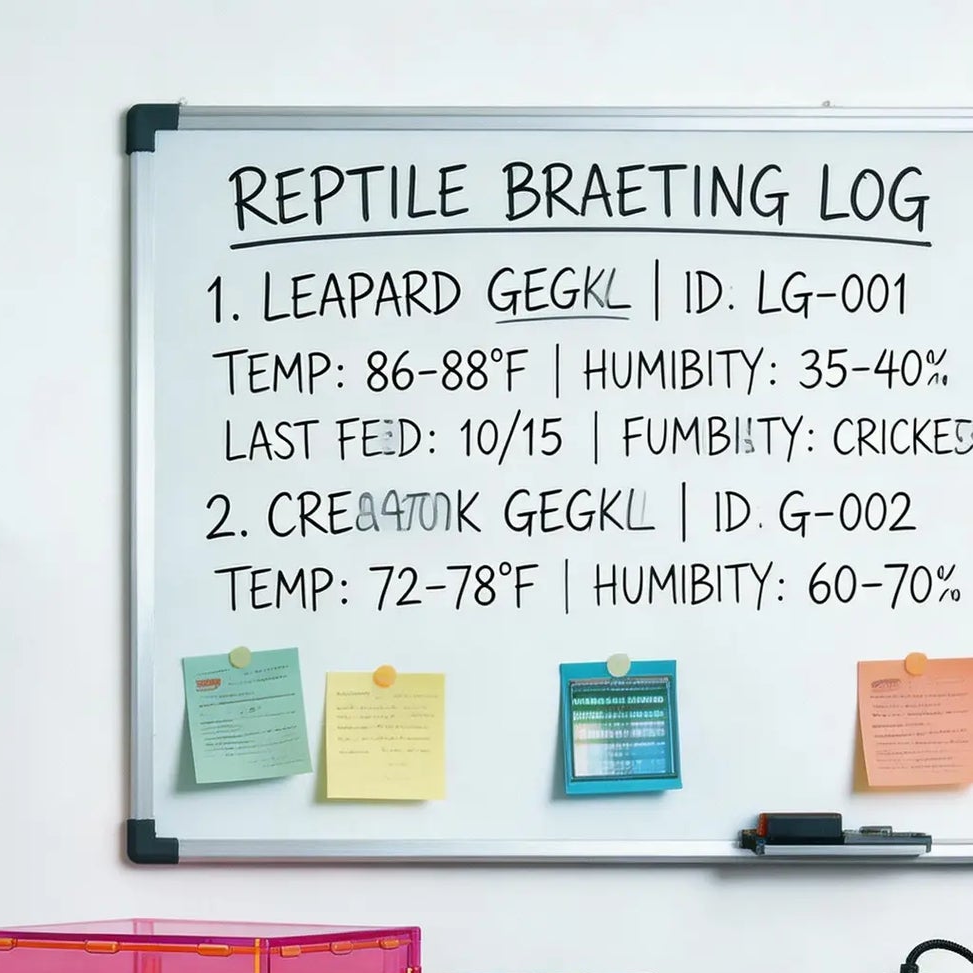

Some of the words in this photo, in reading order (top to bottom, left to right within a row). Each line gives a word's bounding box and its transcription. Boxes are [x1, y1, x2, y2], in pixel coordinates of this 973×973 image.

[228, 163, 470, 232] REPTILE
[501, 161, 791, 227] BRAETING
[819, 163, 931, 233] LOG
[207, 275, 240, 324] 1.
[263, 270, 462, 322] LEAPARD
[757, 269, 907, 320] LG-001
[211, 348, 344, 396] TEMP:
[366, 347, 529, 393] 86-88°F
[583, 346, 777, 396] HUMIBITY:
[225, 419, 320, 462] LAST
[460, 408, 563, 466] 10/15
[205, 493, 248, 540] 2.
[778, 489, 918, 539] G-002
[213, 565, 348, 613] TEMP:
[368, 561, 540, 612] 72-78°F
[593, 560, 785, 611] HUMIBITY:
[808, 561, 961, 610] 60-70%
